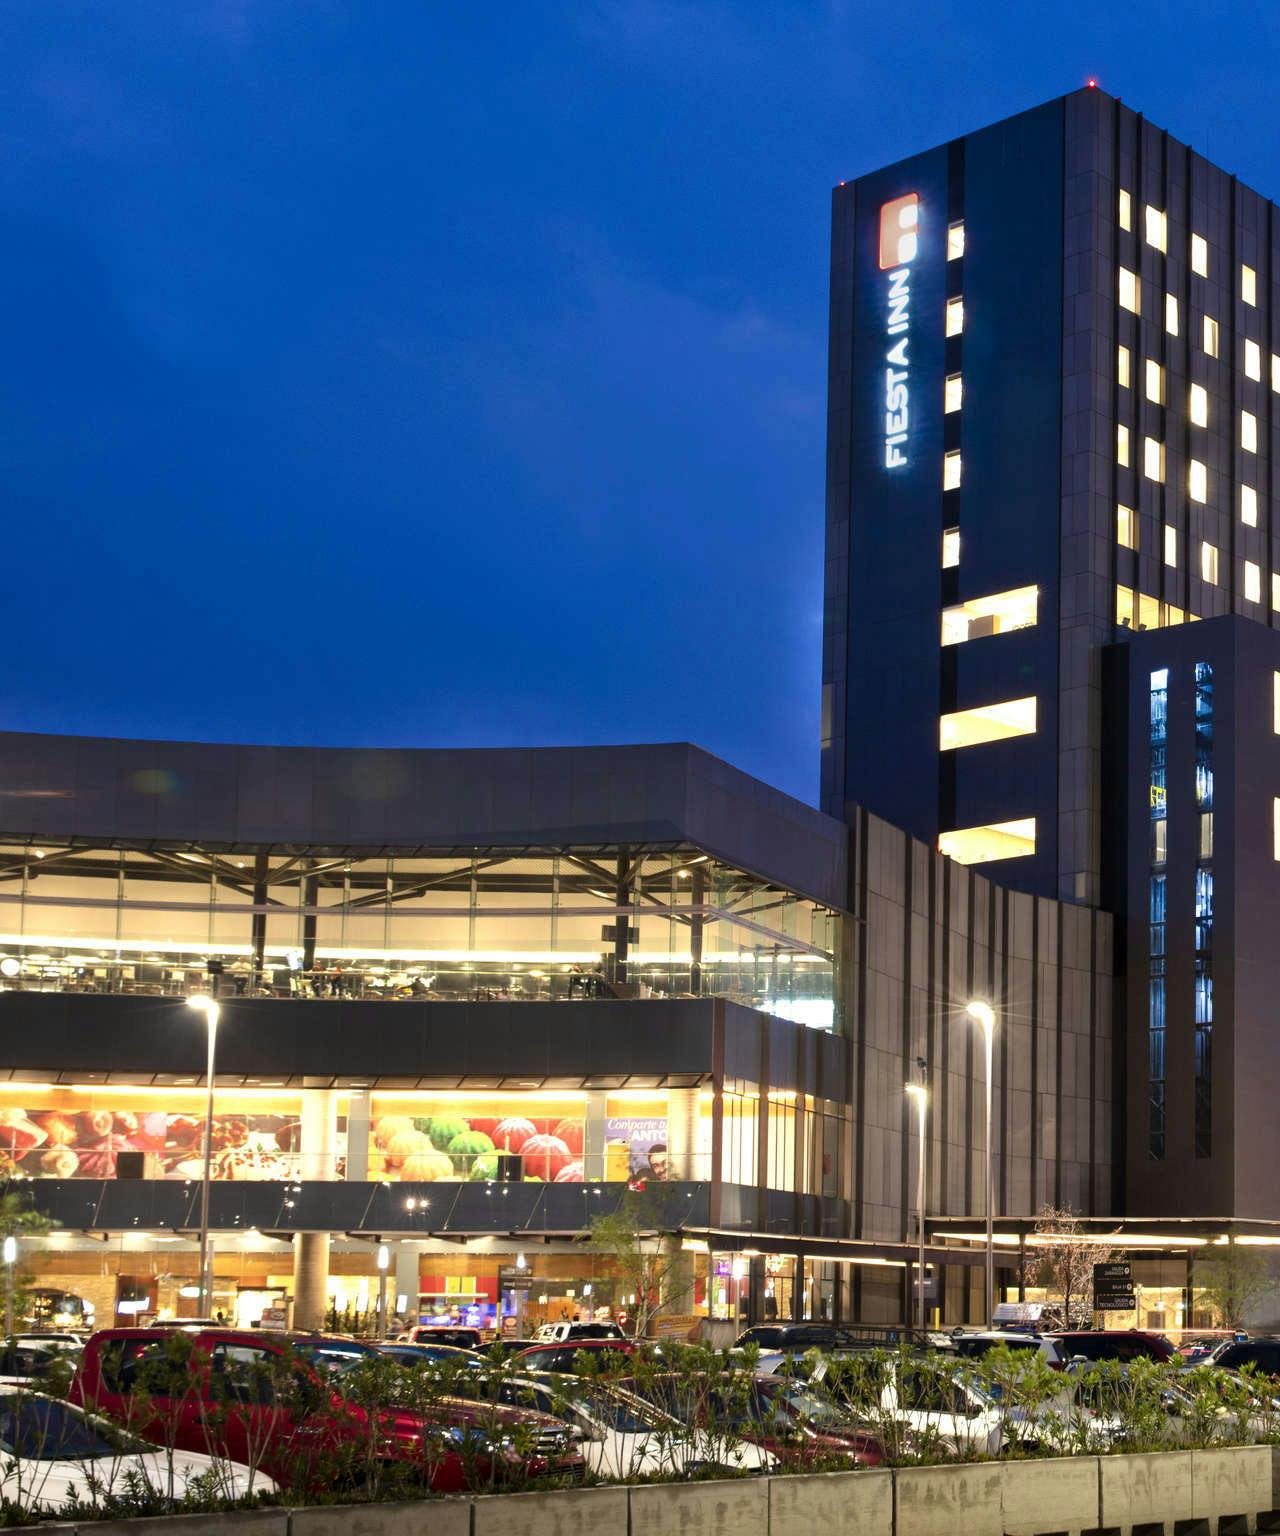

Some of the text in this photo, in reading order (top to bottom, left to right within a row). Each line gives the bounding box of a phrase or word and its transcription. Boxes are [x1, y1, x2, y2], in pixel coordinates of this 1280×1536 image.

[886, 268, 910, 469] FIESTA INN
[607, 1119, 657, 1131] Comparte
